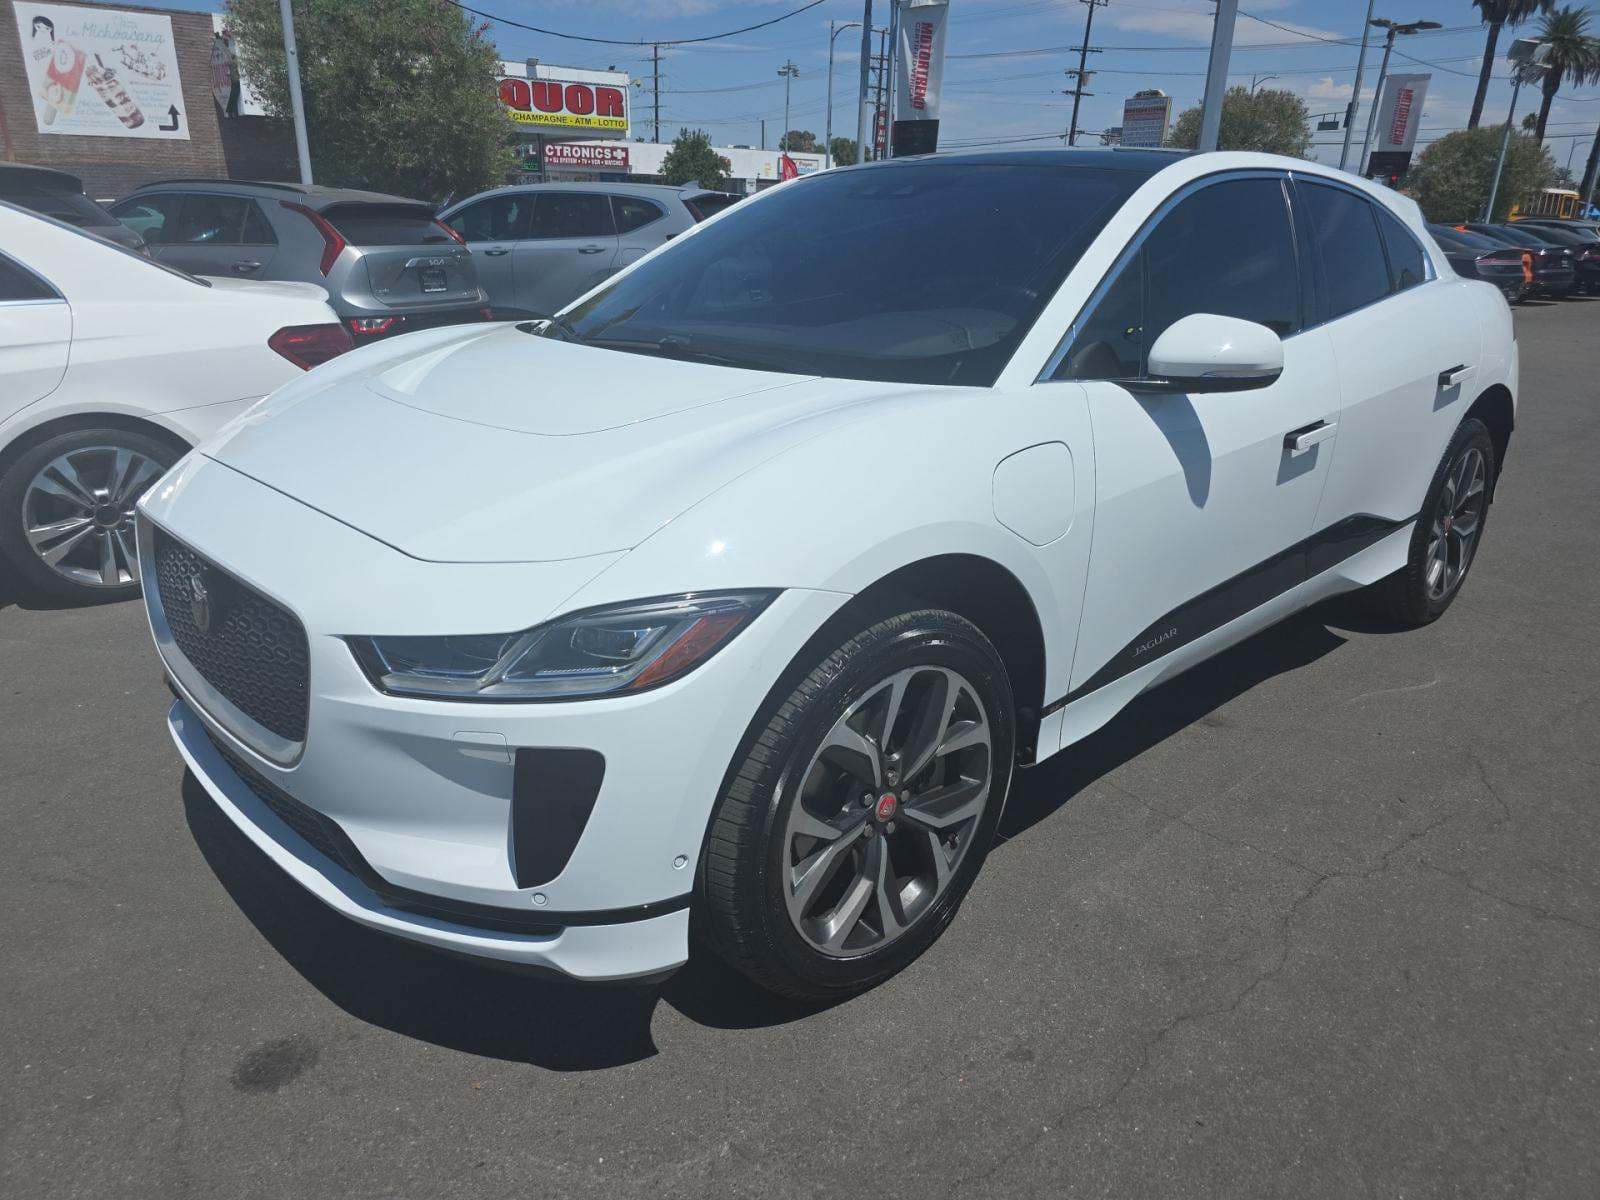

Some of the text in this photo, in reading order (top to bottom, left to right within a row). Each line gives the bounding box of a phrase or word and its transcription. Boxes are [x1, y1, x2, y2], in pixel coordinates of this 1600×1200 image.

[913, 22, 934, 110] MOTORTREND
[513, 113, 625, 128] CHAMPAGNE ATM LOTTO
[1132, 628, 1177, 657] JAGUAR
